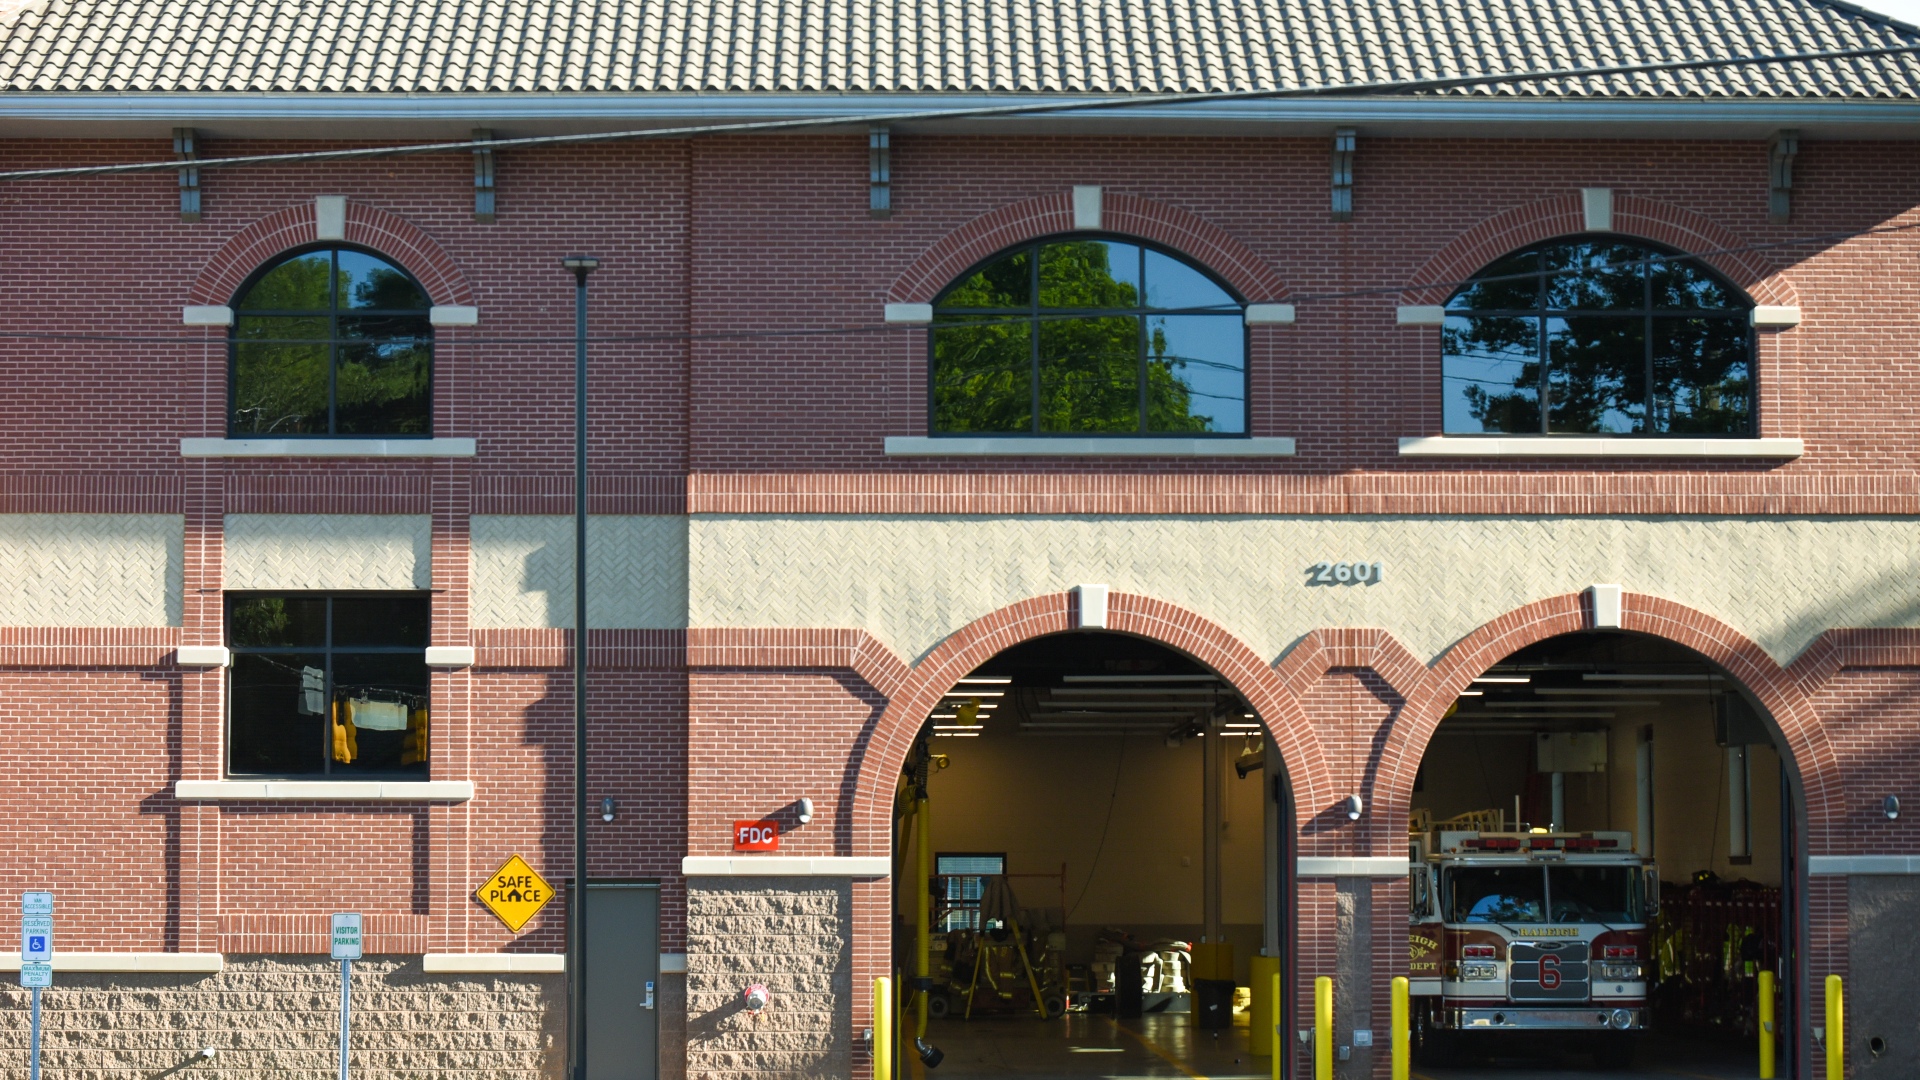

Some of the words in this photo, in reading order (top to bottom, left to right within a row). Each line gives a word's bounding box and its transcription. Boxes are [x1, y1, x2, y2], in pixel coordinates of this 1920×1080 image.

[1316, 561, 1383, 582] 2601
[740, 827, 773, 844] FDC
[498, 875, 532, 888] SAFE
[1519, 928, 1579, 937] RALEIGH
[1539, 954, 1562, 991] 6
